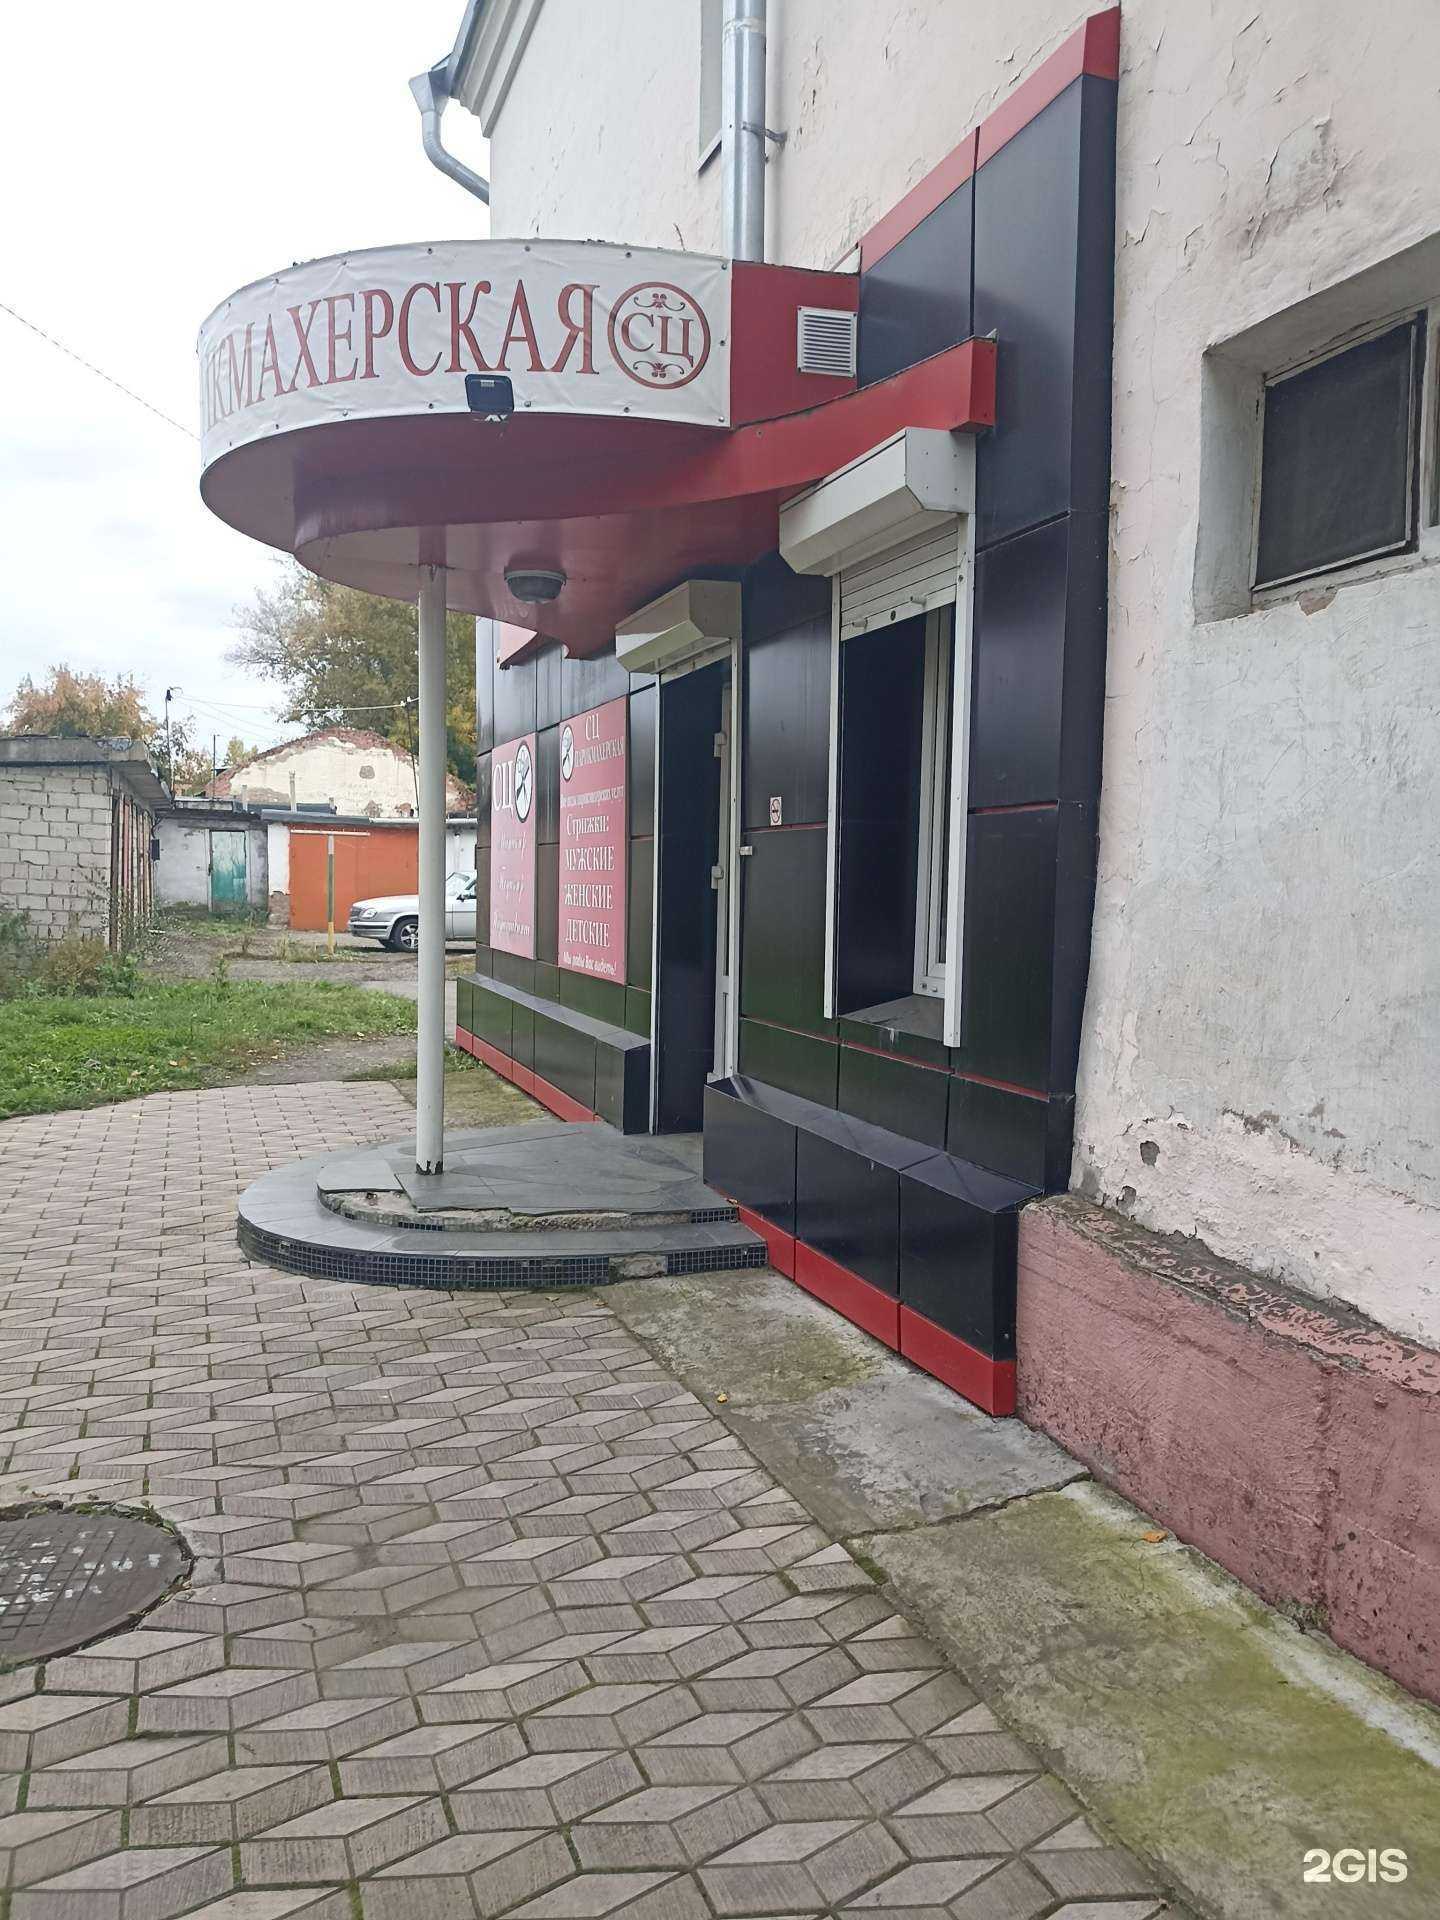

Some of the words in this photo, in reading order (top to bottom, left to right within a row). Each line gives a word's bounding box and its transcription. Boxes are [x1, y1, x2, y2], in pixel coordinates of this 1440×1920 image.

[621, 312, 694, 367] СЦ
[585, 713, 600, 741] СЦ
[565, 846, 615, 871] МУЖСКИЕ
[564, 884, 614, 910] ЖЕНСКИЕ
[565, 919, 611, 948] ДЕТСКИЕ
